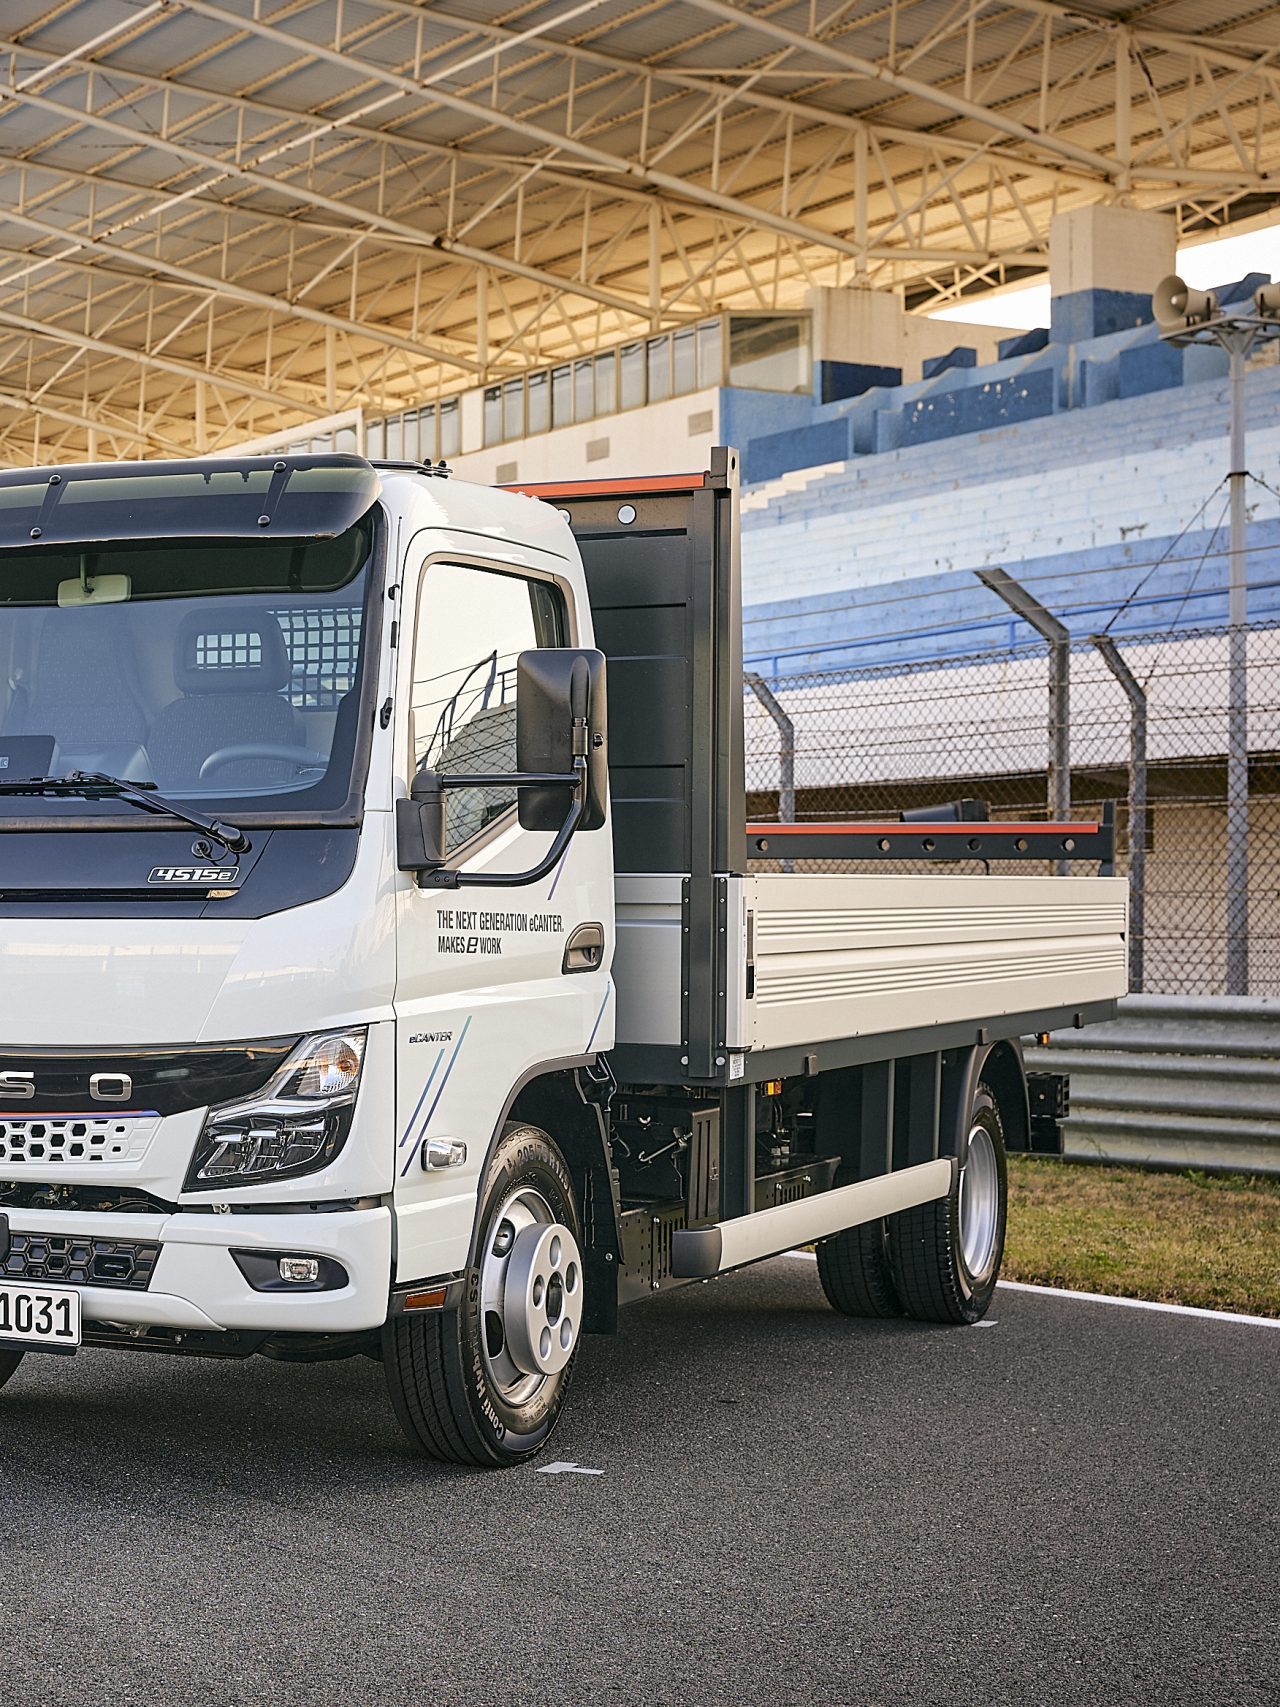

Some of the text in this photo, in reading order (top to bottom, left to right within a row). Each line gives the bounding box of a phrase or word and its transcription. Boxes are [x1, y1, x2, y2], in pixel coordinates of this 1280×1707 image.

[437, 909, 454, 929] THE
[456, 910, 477, 930] NEXT
[479, 911, 528, 932] GENERATION
[438, 935, 465, 953] MAKES
[480, 937, 502, 954] WORK
[409, 1031, 453, 1043] eCANTER
